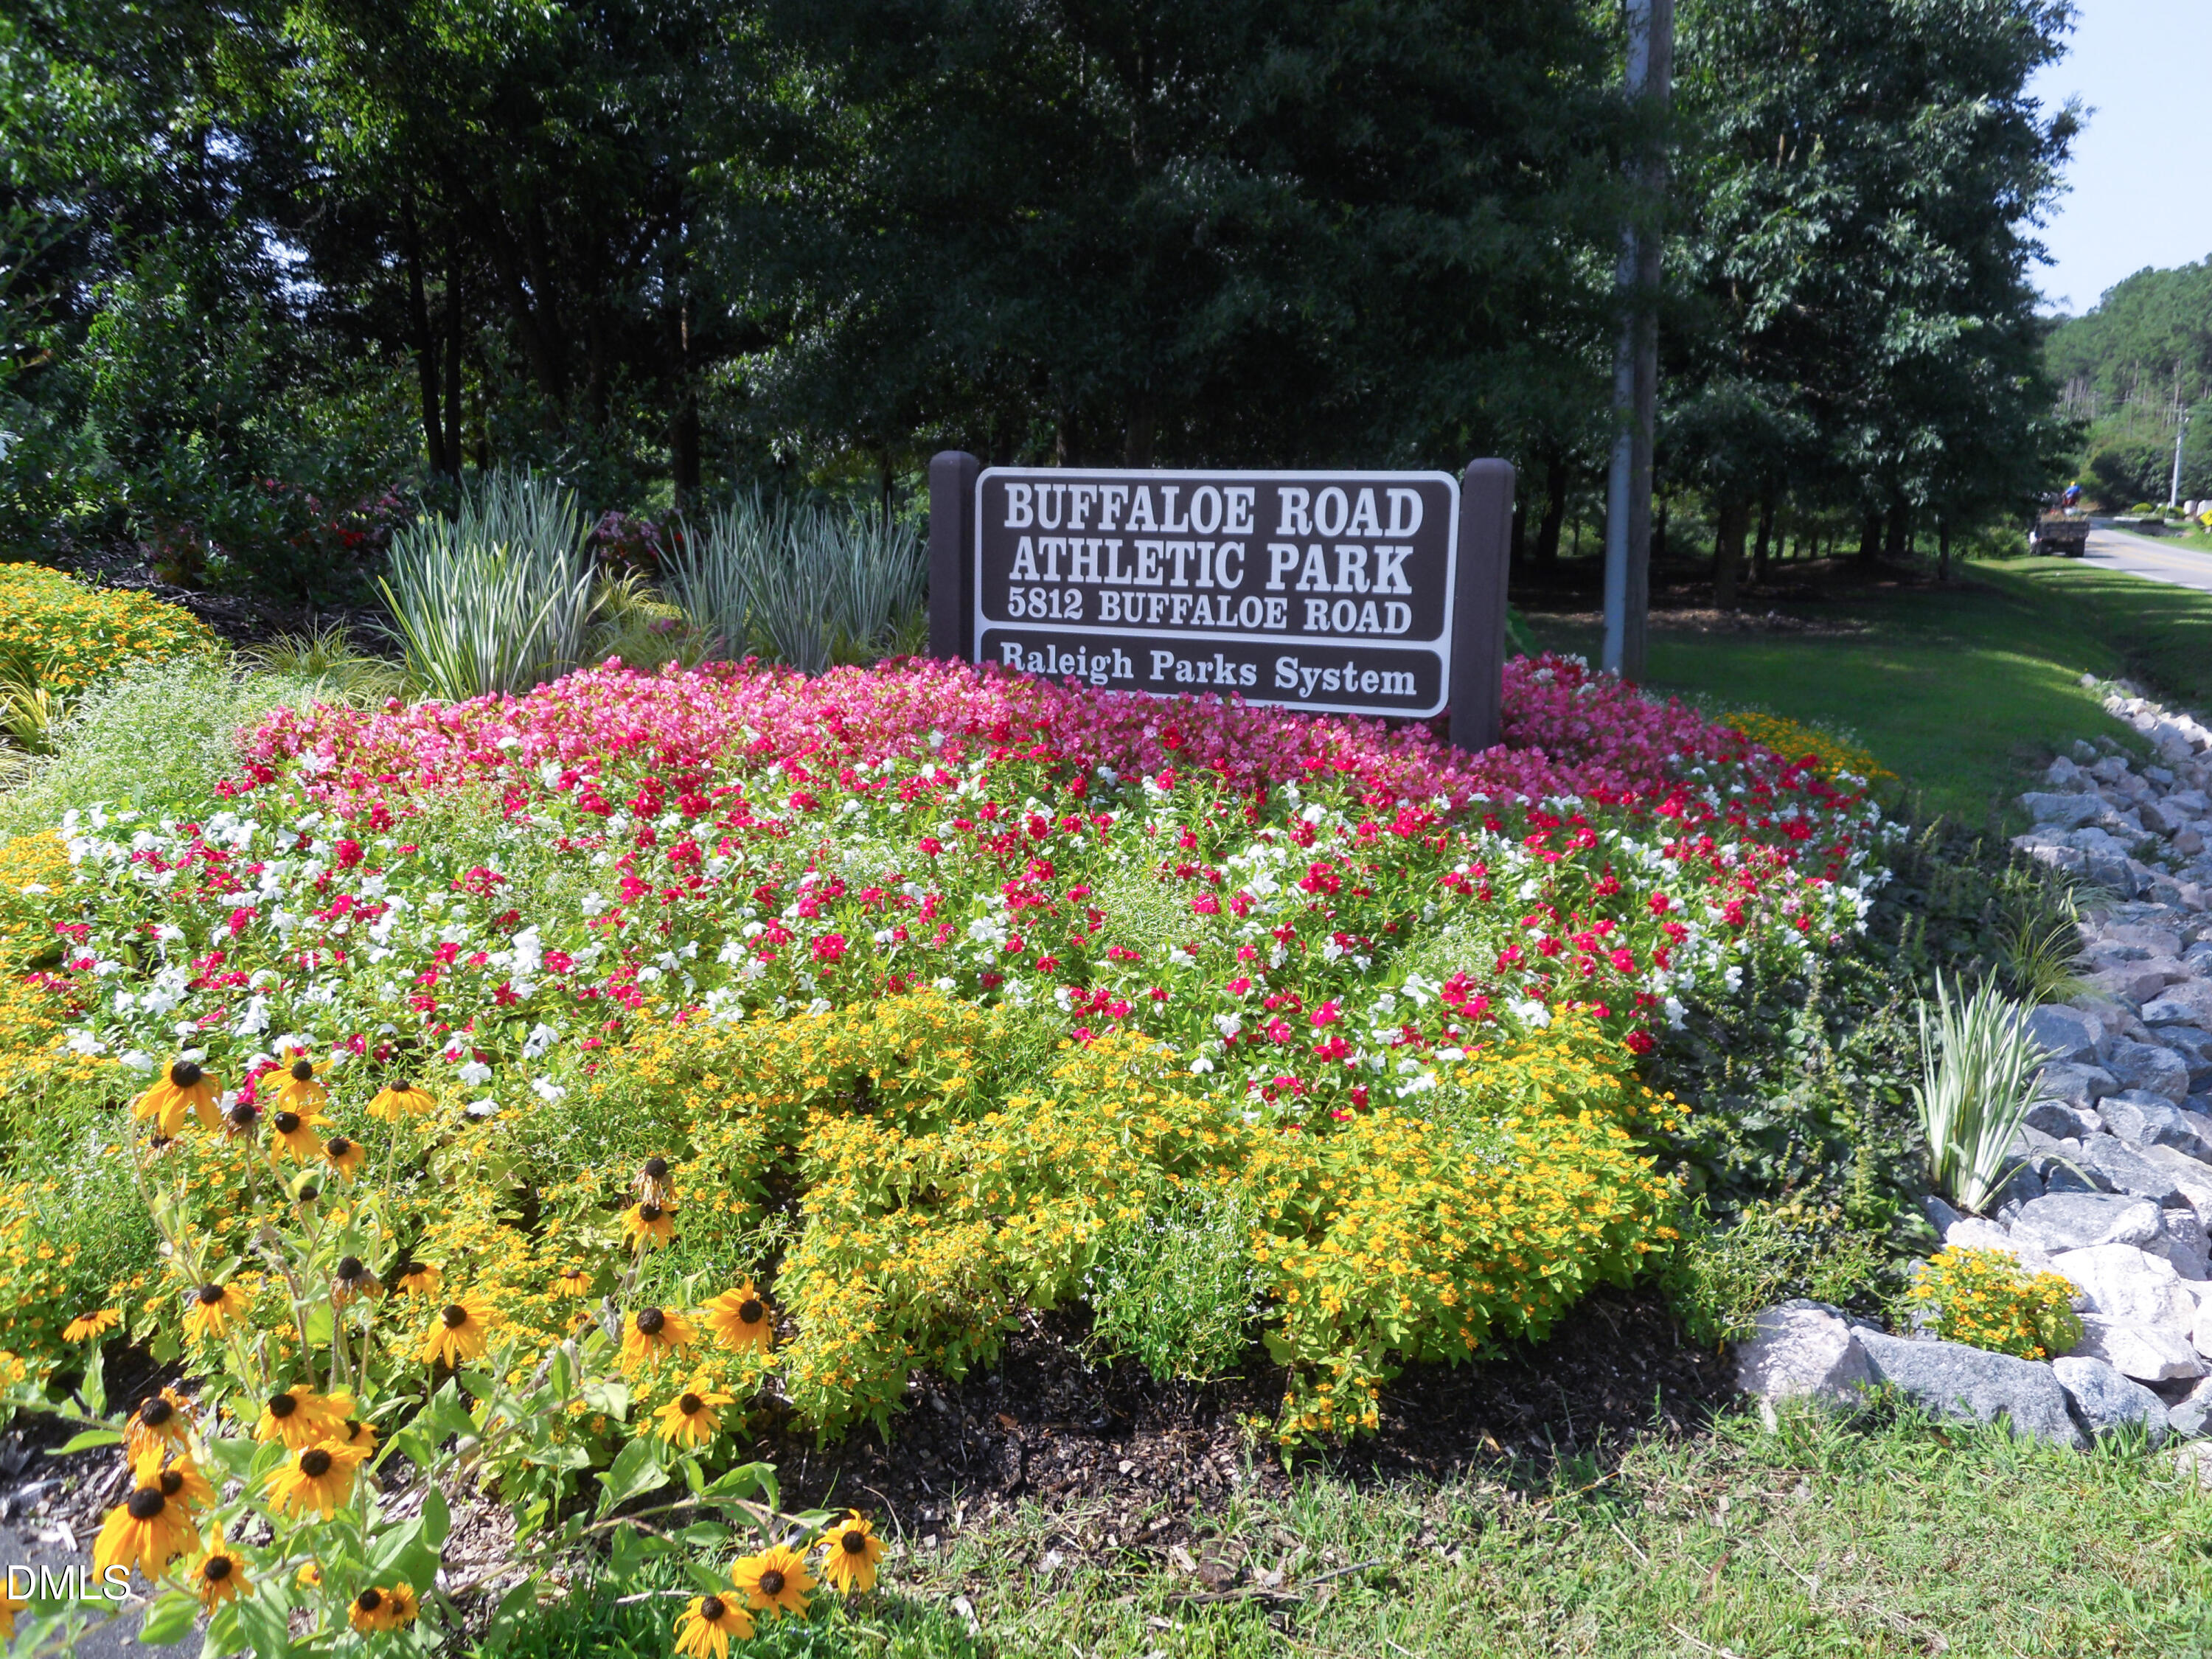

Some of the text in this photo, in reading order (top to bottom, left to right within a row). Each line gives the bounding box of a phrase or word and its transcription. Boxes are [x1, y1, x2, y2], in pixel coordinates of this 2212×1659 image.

[1004, 482, 1425, 538] BUFFALOE ROAD
[1009, 536, 1413, 594] ATHLETIC PARK
[1007, 587, 1412, 635] 5812 BUFFALOE ROAD
[1000, 641, 1416, 698] Raleigh Parks System
